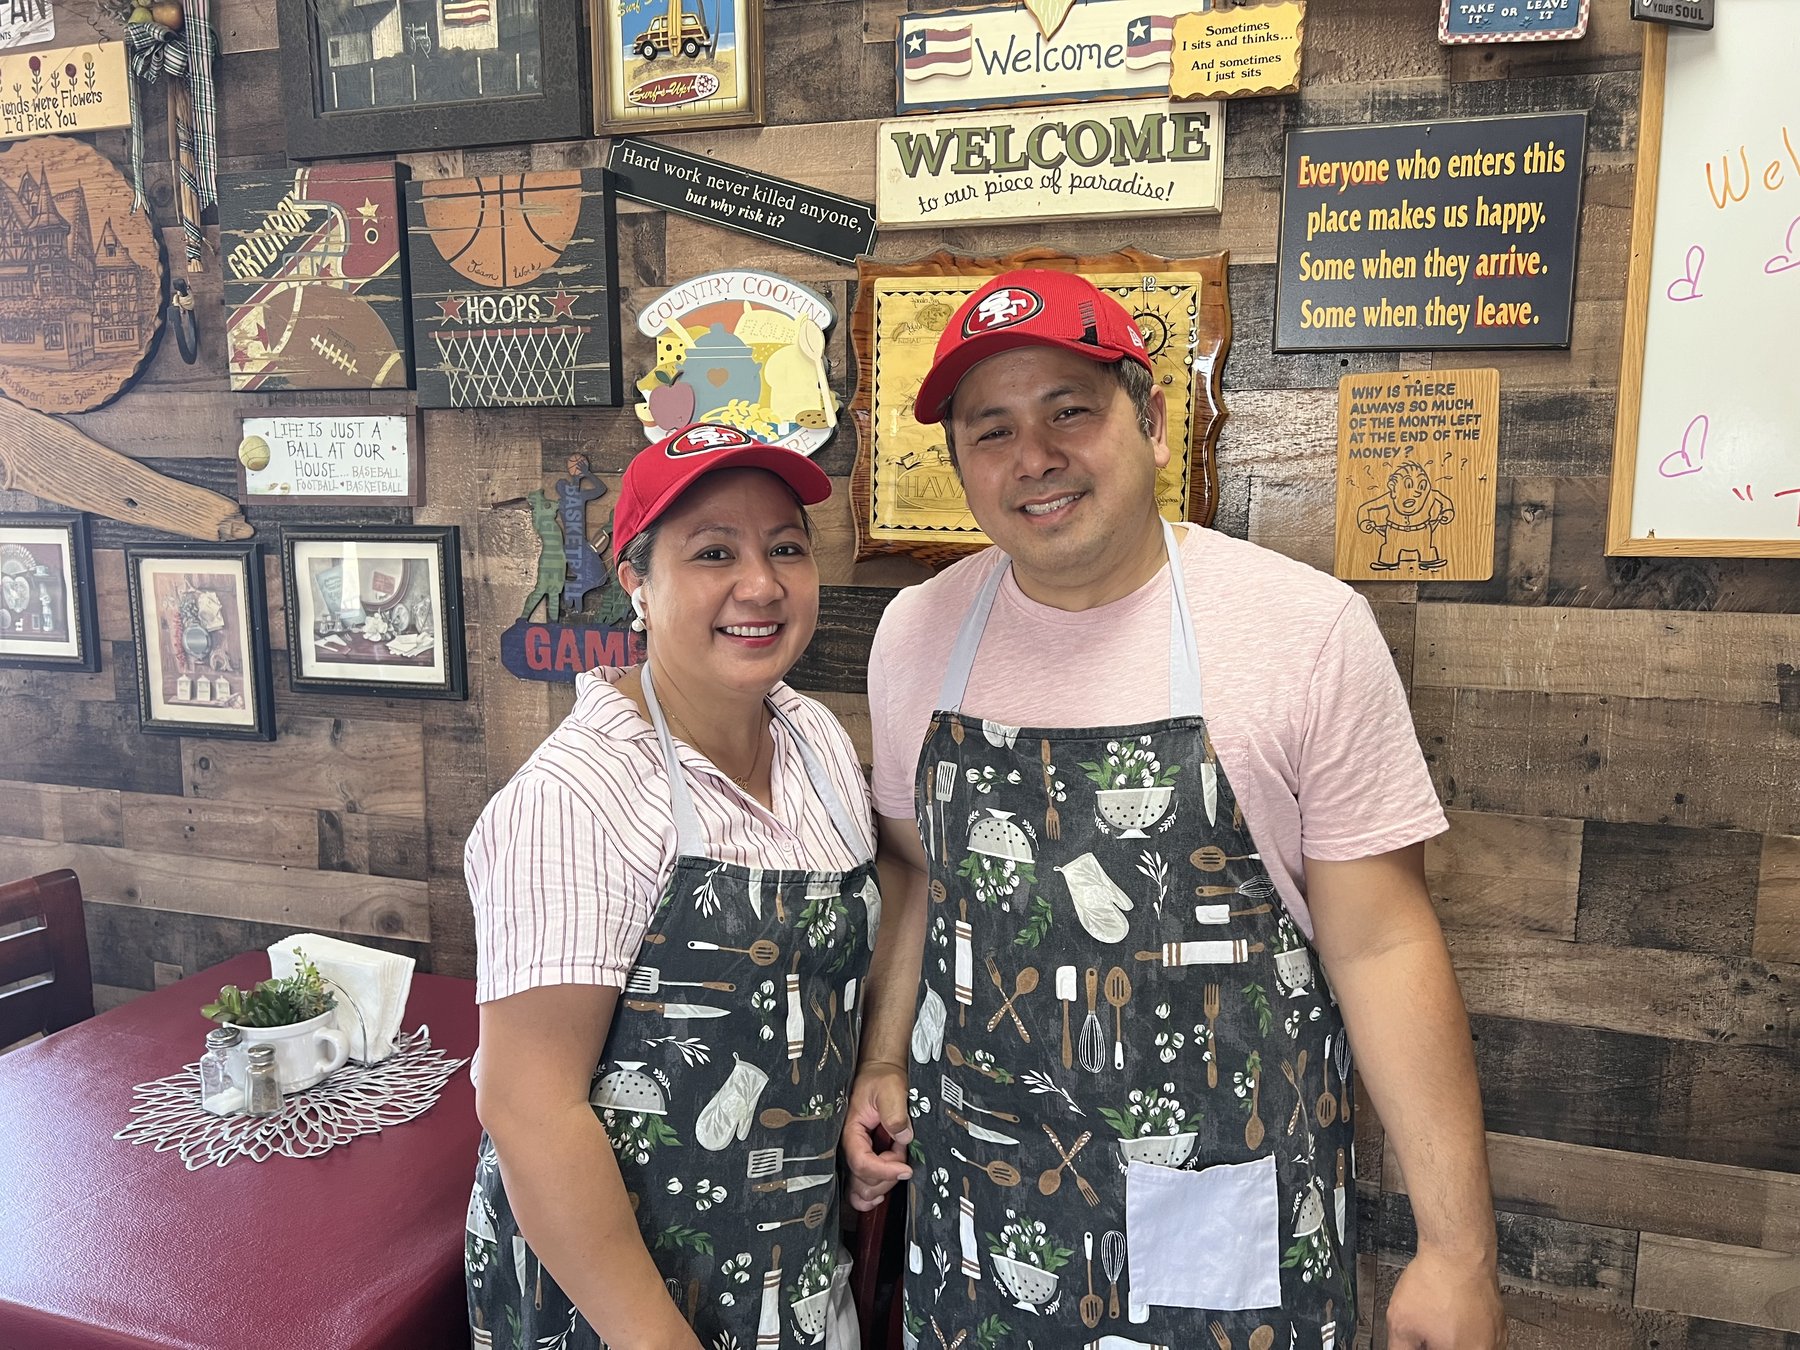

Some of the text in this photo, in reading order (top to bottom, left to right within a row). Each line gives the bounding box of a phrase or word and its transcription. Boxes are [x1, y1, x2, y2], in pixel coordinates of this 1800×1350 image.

[0, 0, 46, 26] AN
[1460, 0, 1569, 17] TAKE OR LEAVE
[1468, 10, 1554, 24] IT IT
[1654, 3, 1673, 15] YOUR
[1675, 4, 1704, 20] SOUL
[1205, 22, 1270, 36] Sometimes
[1182, 32, 1293, 51] I sits and thinks...
[974, 31, 1125, 76] Welcome
[1191, 54, 1282, 71] And sometimes
[1206, 68, 1262, 82] I just sits
[0, 95, 29, 117] iends
[61, 89, 103, 108] Flowers
[4, 109, 77, 134] I'd Pick You
[890, 111, 1211, 179] WELCOME
[1297, 141, 1565, 194] Everyone who enters this
[622, 147, 862, 233] Hard work never killed anyone,
[918, 167, 1175, 215] to our piece of paradise!
[685, 188, 785, 228] but why risk it?
[1307, 195, 1546, 241] place makes us happy.
[227, 190, 313, 282] GRIDIRON
[467, 260, 499, 280] Team
[1299, 244, 1548, 286] Some when they arrive.
[1142, 276, 1156, 292] 12
[466, 294, 541, 325] HOOPS
[647, 276, 826, 328] COUNTRY COOKIN'
[1300, 295, 1540, 335] Some when they leave.
[741, 319, 796, 344] FLOUR
[1188, 327, 1198, 342] 3
[1351, 383, 1456, 400] WHY IS THERE
[1350, 399, 1474, 415] ALWAYS SO MUCH
[273, 420, 382, 440] LIFE IS JUST A
[1349, 414, 1481, 430] OF THE MONTH LEFT
[783, 429, 817, 453] RE
[1349, 429, 1480, 444] AT THE END OF THE
[287, 440, 385, 460] BALL AT OUR
[352, 465, 401, 479] BASEBALL
[296, 478, 403, 493] FOOTBALL BASKETBALL
